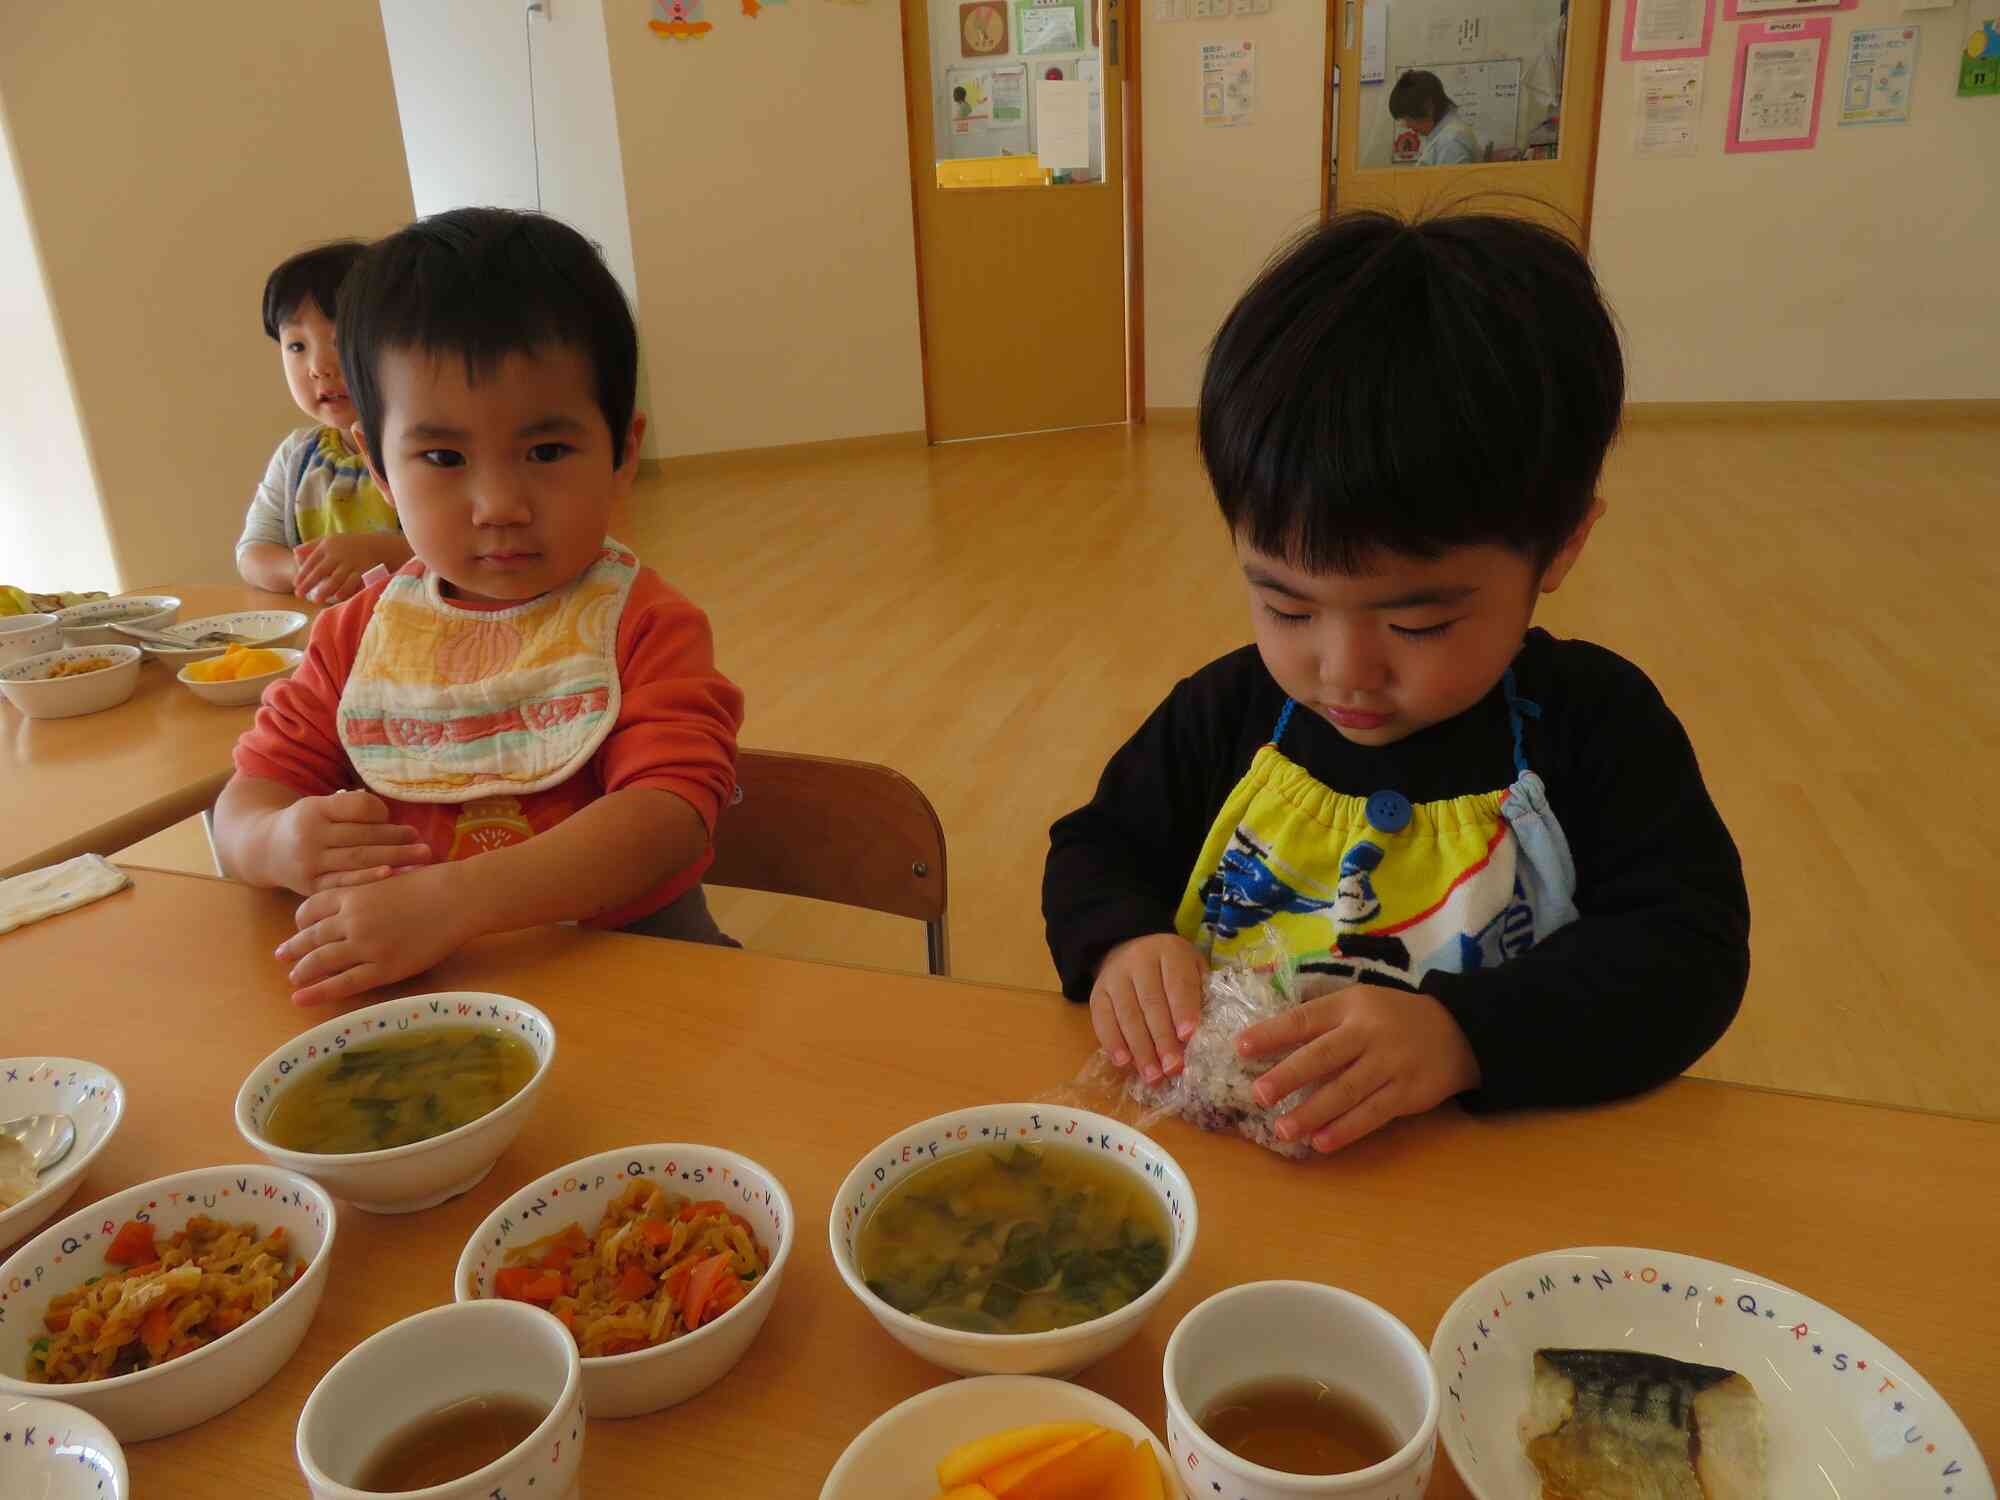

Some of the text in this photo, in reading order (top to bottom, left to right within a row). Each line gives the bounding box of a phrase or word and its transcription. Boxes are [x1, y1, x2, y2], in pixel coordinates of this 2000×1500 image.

[280, 1060, 294, 1075] Q
[308, 1045, 317, 1058] R
[335, 1035, 347, 1049] S
[361, 1020, 375, 1033] T
[398, 1016, 409, 1031] U
[429, 1000, 439, 1013] V
[457, 1002, 471, 1016] W
[489, 1004, 500, 1018] X
[6, 1069, 18, 1083] X
[501, 1217, 514, 1236] M
[531, 1198, 548, 1217] N
[563, 1178, 577, 1193] O
[595, 1176, 605, 1190] P
[627, 1161, 645, 1177] Q
[664, 1160, 677, 1176] R
[694, 1168, 705, 1183] S
[721, 1168, 733, 1183] T
[742, 1187, 752, 1203] U
[874, 1166, 886, 1181] D
[901, 1145, 912, 1162] E
[928, 1141, 939, 1158] F
[957, 1125, 968, 1140] G
[993, 1126, 1008, 1140] H
[1030, 1113, 1042, 1129] I
[1065, 1119, 1078, 1135] J
[1100, 1133, 1111, 1150] K
[1153, 1163, 1164, 1181] M
[1171, 1199, 1179, 1216] N
[9, 1278, 21, 1294] O
[35, 1266, 44, 1282] P
[62, 1237, 82, 1255] Q
[102, 1220, 114, 1235] R
[136, 1210, 150, 1224] S
[203, 1195, 217, 1209] U
[236, 1178, 247, 1193] V
[264, 1183, 279, 1199] W
[293, 1191, 302, 1207] X
[1476, 1319, 1491, 1338] K
[1500, 1289, 1512, 1308] L
[1539, 1275, 1556, 1295] M
[1592, 1269, 1613, 1291] N
[1640, 1267, 1658, 1284] O
[1685, 1285, 1698, 1301] P
[1736, 1294, 1759, 1317] Q
[1789, 1323, 1808, 1341] R
[1832, 1353, 1849, 1372] S
[1877, 1376, 1896, 1393] T
[1903, 1425, 1924, 1444] U
[1941, 1459, 1963, 1477] V
[24, 1426, 36, 1447] K
[550, 1439, 561, 1464] J
